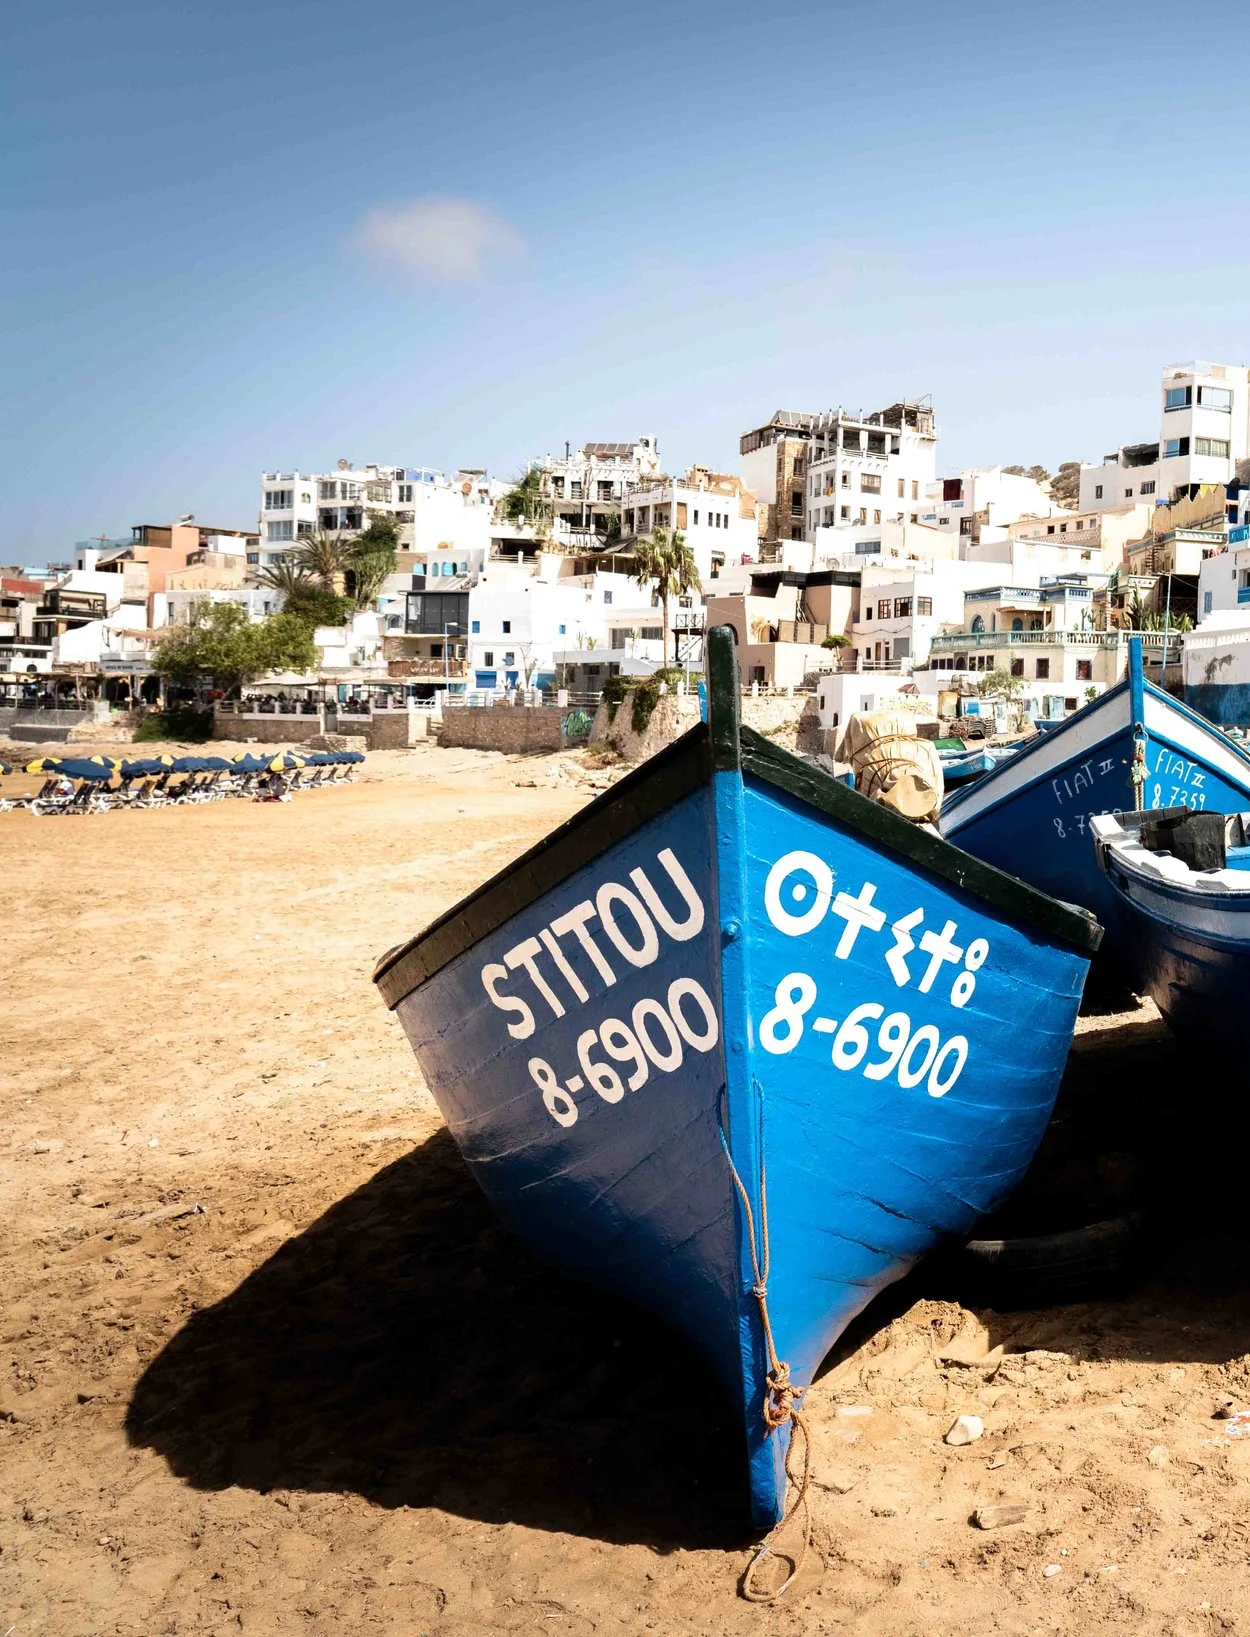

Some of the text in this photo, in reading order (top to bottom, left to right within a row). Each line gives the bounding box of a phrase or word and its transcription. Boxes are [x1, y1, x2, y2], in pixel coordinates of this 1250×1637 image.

[1052, 759, 1094, 805] FIAT
[1155, 748, 1198, 783] FIAT
[481, 847, 705, 1040] STITOU
[527, 977, 719, 1128] 8-6900
[758, 971, 969, 1098] 8-6900
